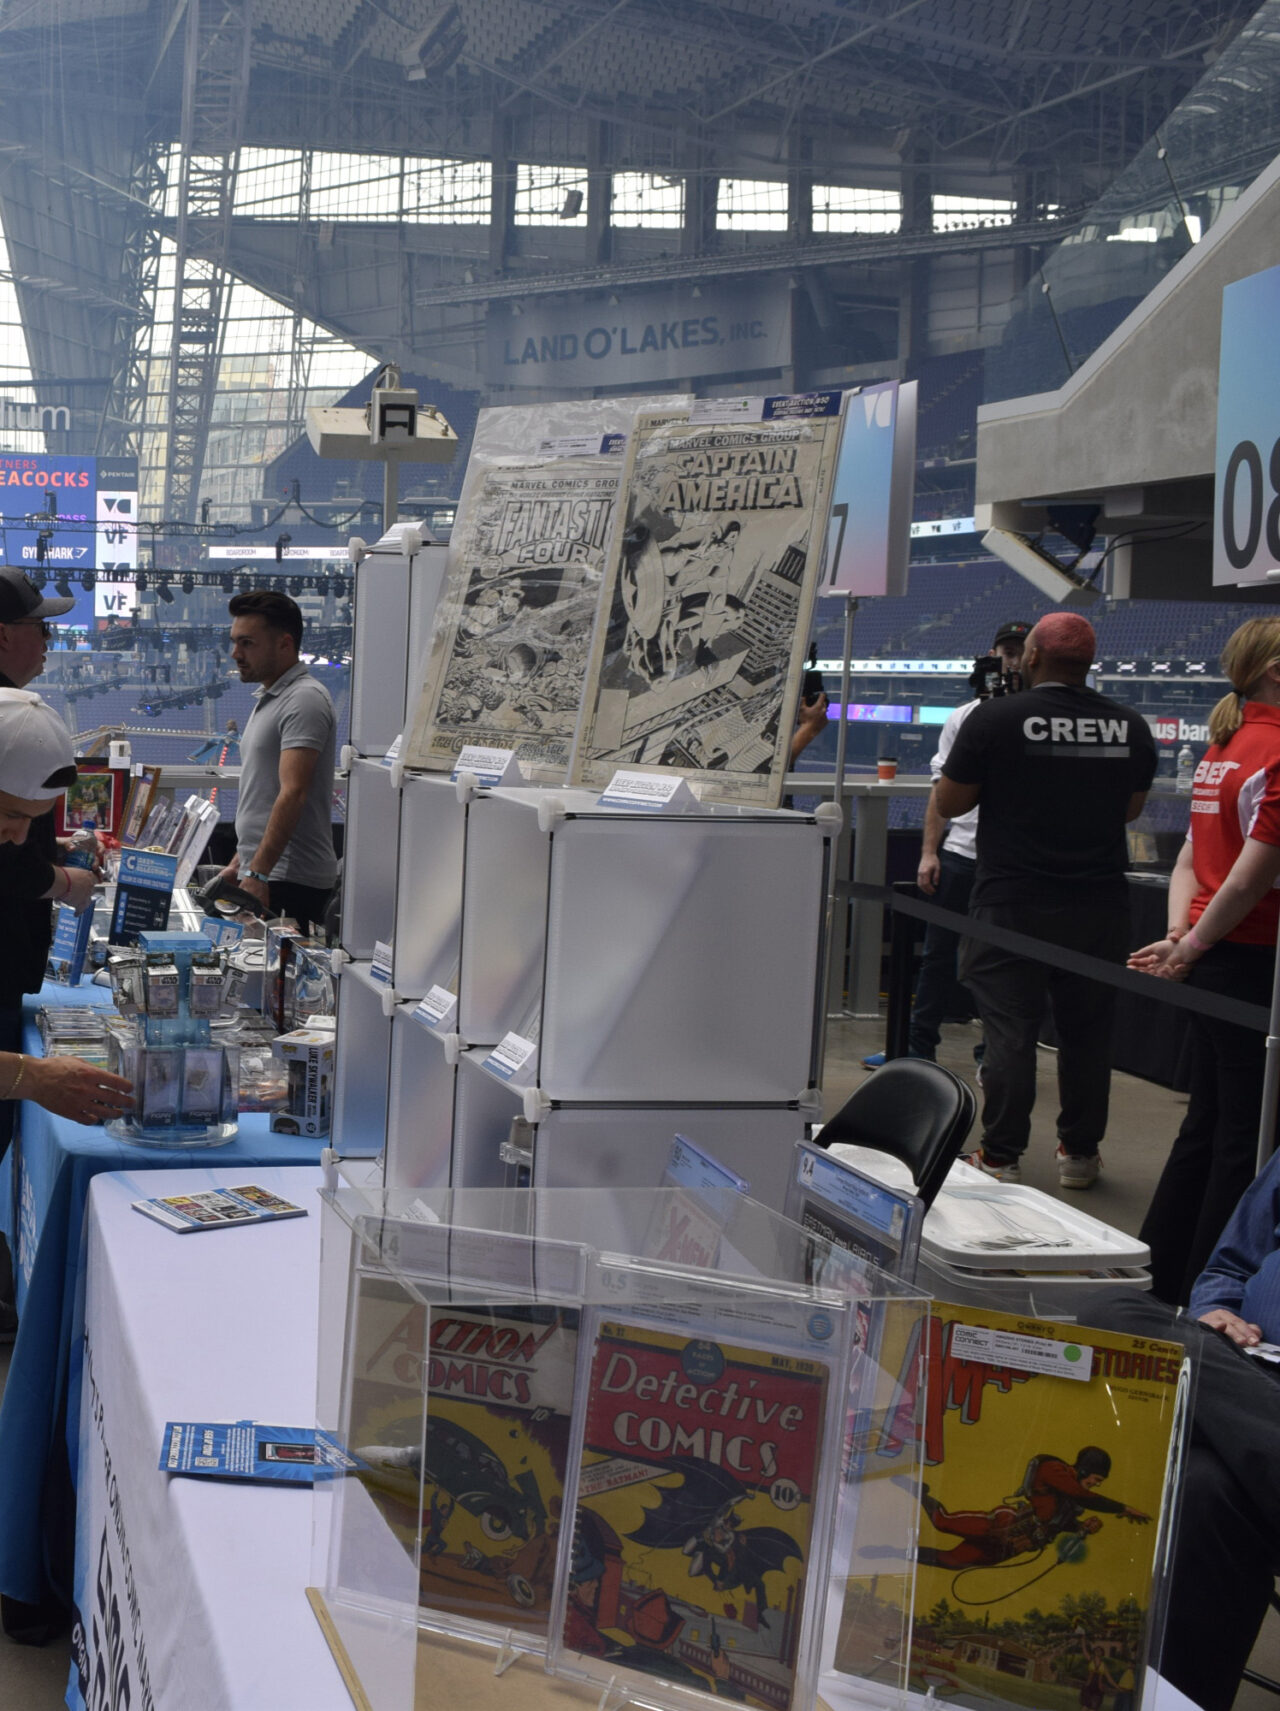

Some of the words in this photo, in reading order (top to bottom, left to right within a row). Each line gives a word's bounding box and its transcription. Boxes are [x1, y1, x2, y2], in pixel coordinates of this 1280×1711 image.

[504, 333, 579, 366] LAND
[730, 320, 768, 341] INC.
[669, 436, 710, 450] MARVEL
[714, 433, 757, 446] COMICS
[761, 430, 800, 442] GROUP
[675, 447, 799, 479] CAPTAIN
[511, 481, 547, 489] MARVEL
[551, 480, 589, 489] COMICS
[663, 474, 803, 513] AMERICA
[22, 547, 74, 560] GYSHARK
[517, 541, 590, 565] FOUR
[1023, 716, 1128, 744] CREW
[1178, 719, 1211, 742] ban
[308, 1047, 319, 1064] LUKE
[308, 1065, 318, 1104] SKYWALKER
[366, 1303, 564, 1373] ACTION
[1132, 1340, 1146, 1349] 25
[1149, 1343, 1179, 1355] Cents
[393, 1352, 532, 1404] COMICS
[1091, 1345, 1181, 1385] STORIES
[599, 1352, 805, 1432] Detective
[613, 1410, 778, 1478] COMICS
